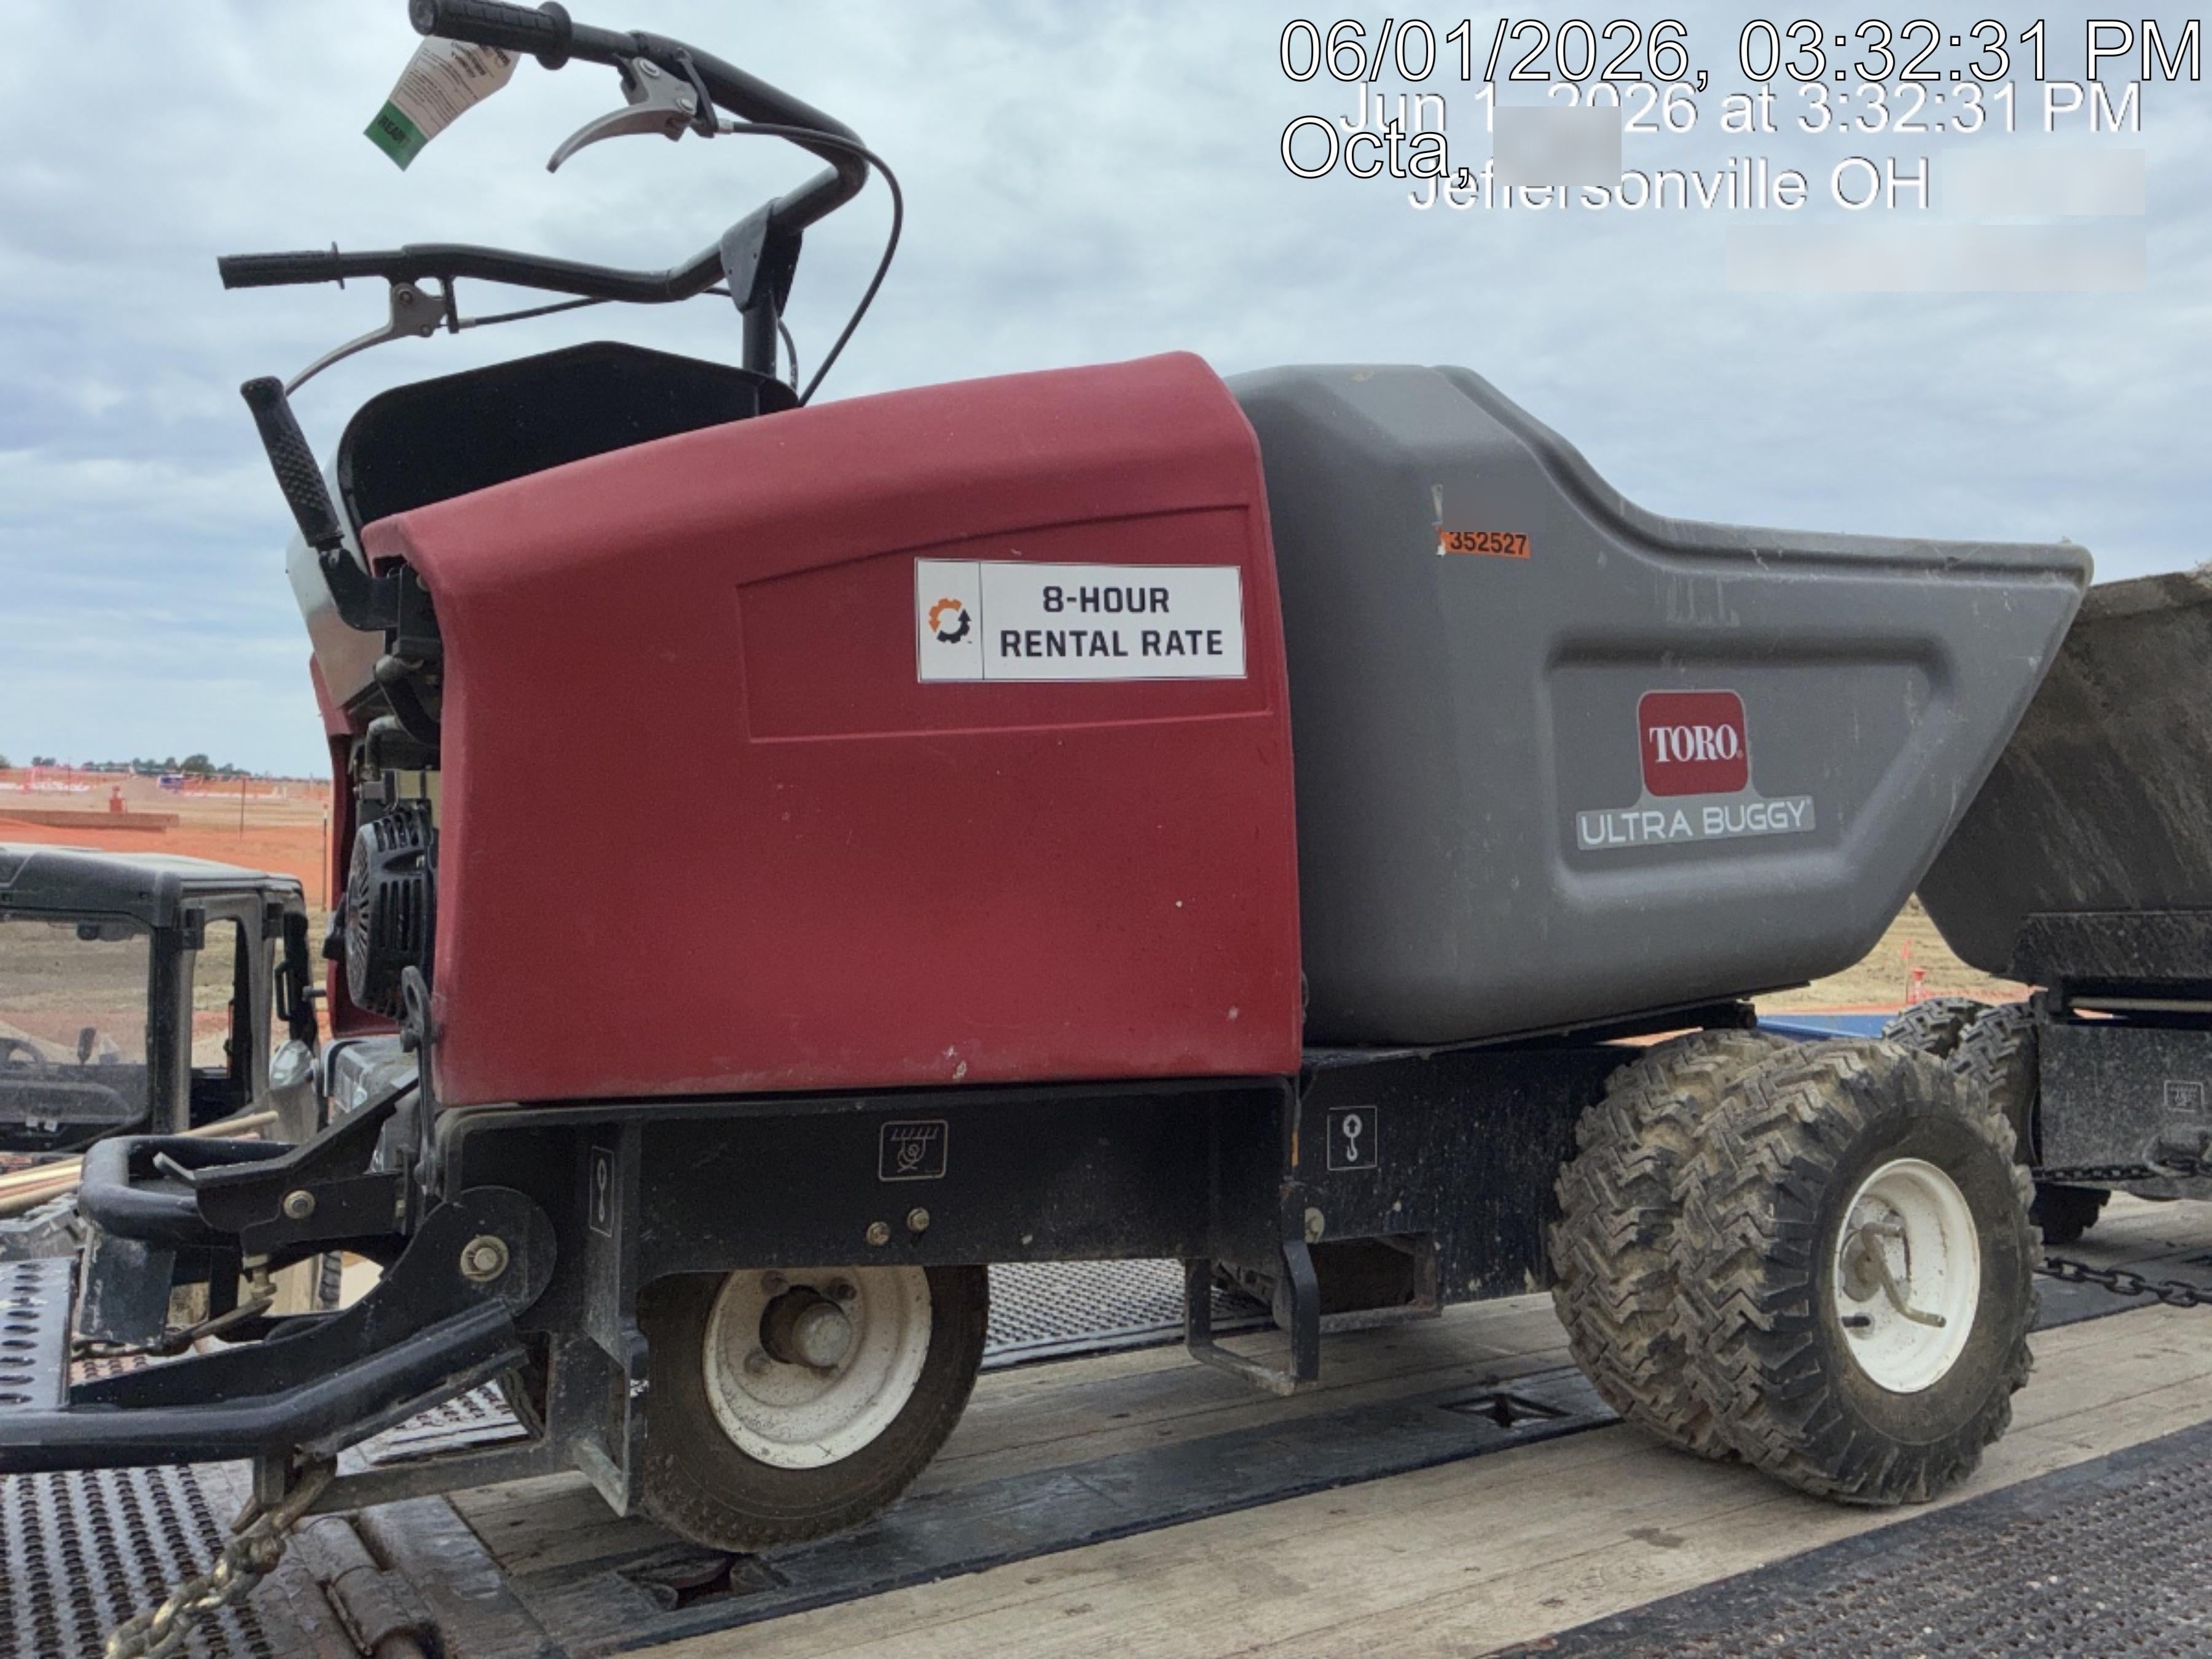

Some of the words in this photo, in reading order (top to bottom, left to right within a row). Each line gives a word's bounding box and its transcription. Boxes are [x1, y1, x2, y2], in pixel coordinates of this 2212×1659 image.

[1449, 531, 1527, 555] 352527
[1043, 586, 1169, 613] 8-HOUR
[1000, 630, 1129, 657] RENTAL
[1142, 630, 1223, 656] RATE
[1649, 723, 1739, 763] TORO
[1580, 809, 1693, 845] ULTRA
[1703, 799, 1805, 835] BUGGY
